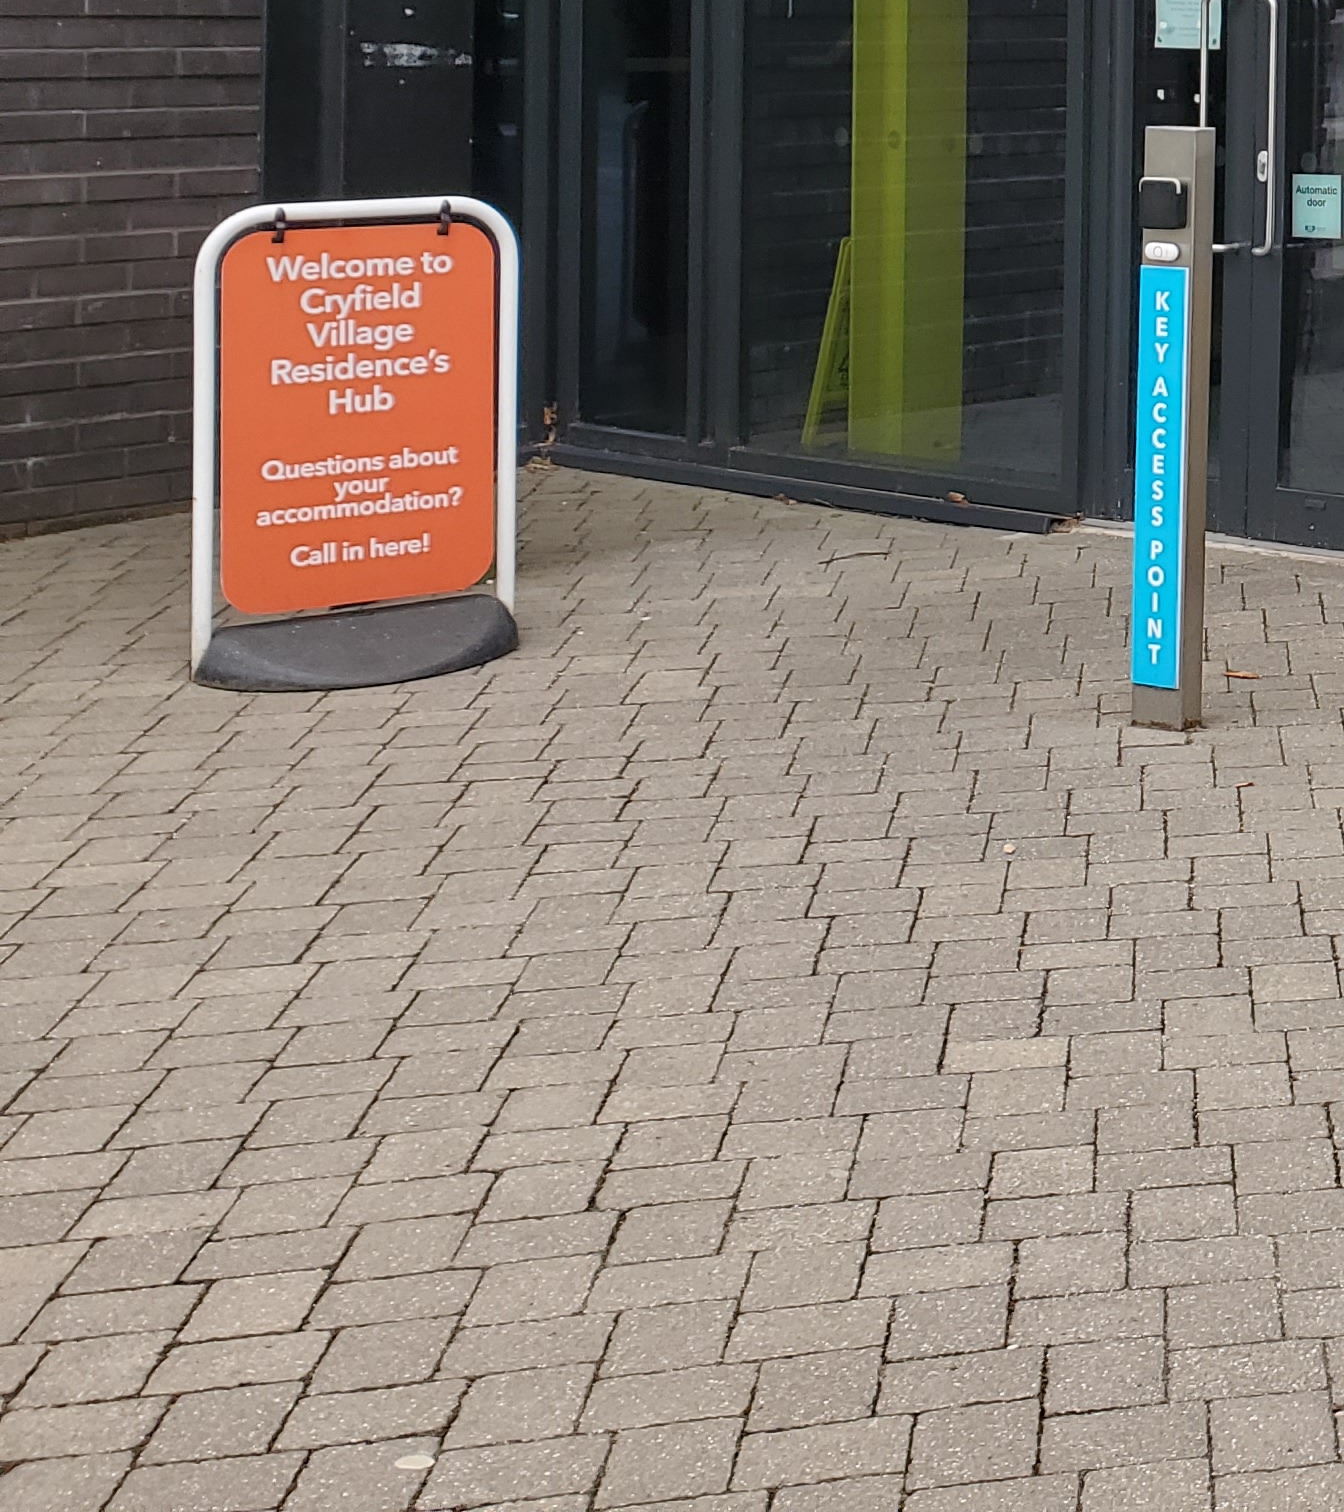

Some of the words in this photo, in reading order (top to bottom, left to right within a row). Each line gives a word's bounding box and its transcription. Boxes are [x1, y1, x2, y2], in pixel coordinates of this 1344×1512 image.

[1296, 185, 1337, 195] Automatic
[1307, 198, 1326, 207] door
[266, 252, 415, 282] Welcome
[420, 252, 453, 274] to
[300, 281, 422, 319] Cryfield
[306, 319, 414, 351] Village
[1155, 291, 1170, 363] KEY
[271, 348, 450, 385] Residence's
[329, 384, 394, 415] Hub
[261, 454, 385, 480] Questions
[389, 446, 459, 469] about
[1151, 376, 1169, 527] ACCESS
[256, 486, 463, 527] accommodation?
[334, 477, 390, 502] your
[290, 542, 337, 567] Call
[342, 542, 364, 561] in
[370, 533, 431, 558] here!
[1147, 540, 1165, 664] POINT
